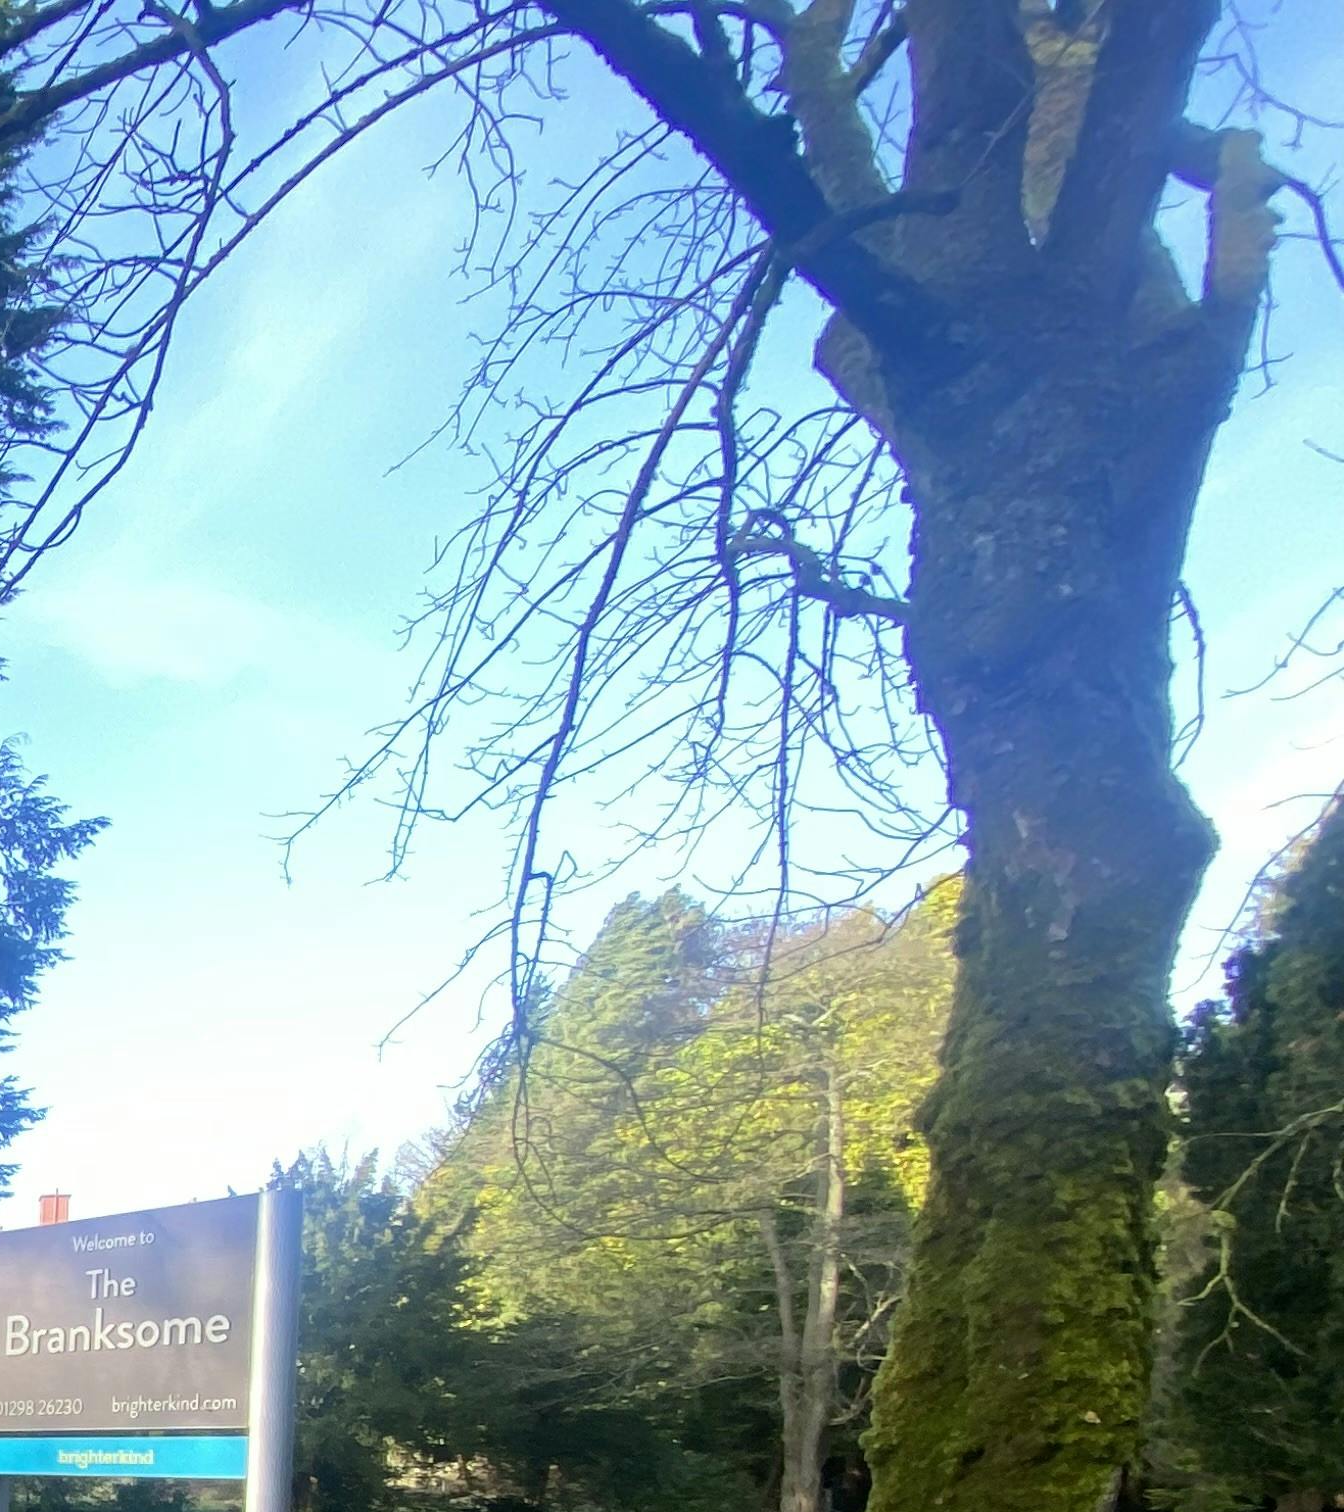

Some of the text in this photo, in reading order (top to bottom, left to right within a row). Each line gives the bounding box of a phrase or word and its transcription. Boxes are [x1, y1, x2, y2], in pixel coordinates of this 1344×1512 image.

[72, 1232, 155, 1252] Welcome to
[86, 1269, 136, 1299] The
[5, 1308, 231, 1356] Branksome
[37, 1398, 83, 1416] 26230
[112, 1393, 237, 1418] brighterkind.com
[58, 1449, 154, 1469] brighterkind
